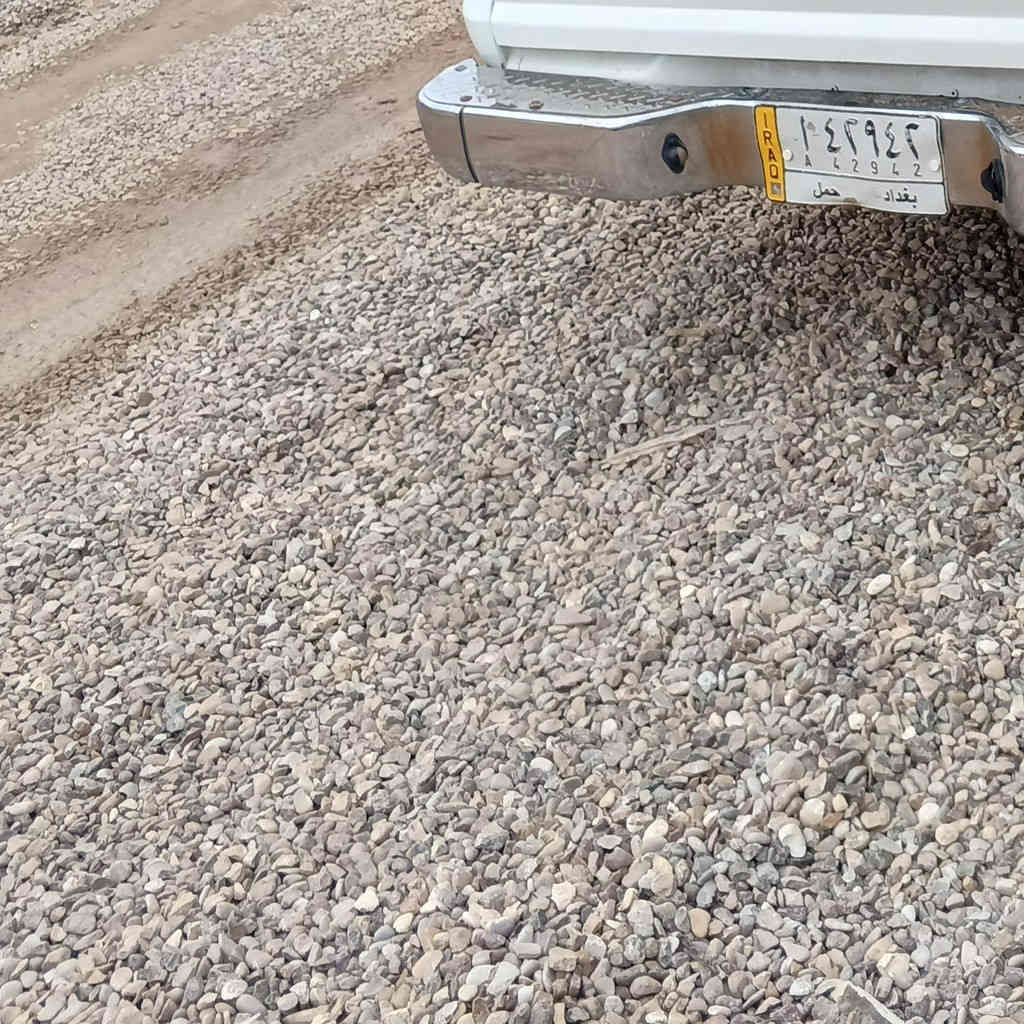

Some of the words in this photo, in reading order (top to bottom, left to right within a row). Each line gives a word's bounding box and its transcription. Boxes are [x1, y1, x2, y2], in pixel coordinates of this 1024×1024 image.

[763, 111, 779, 179] IRAQ
[812, 182, 841, 199] حمل
[884, 187, 919, 208] بغداد
